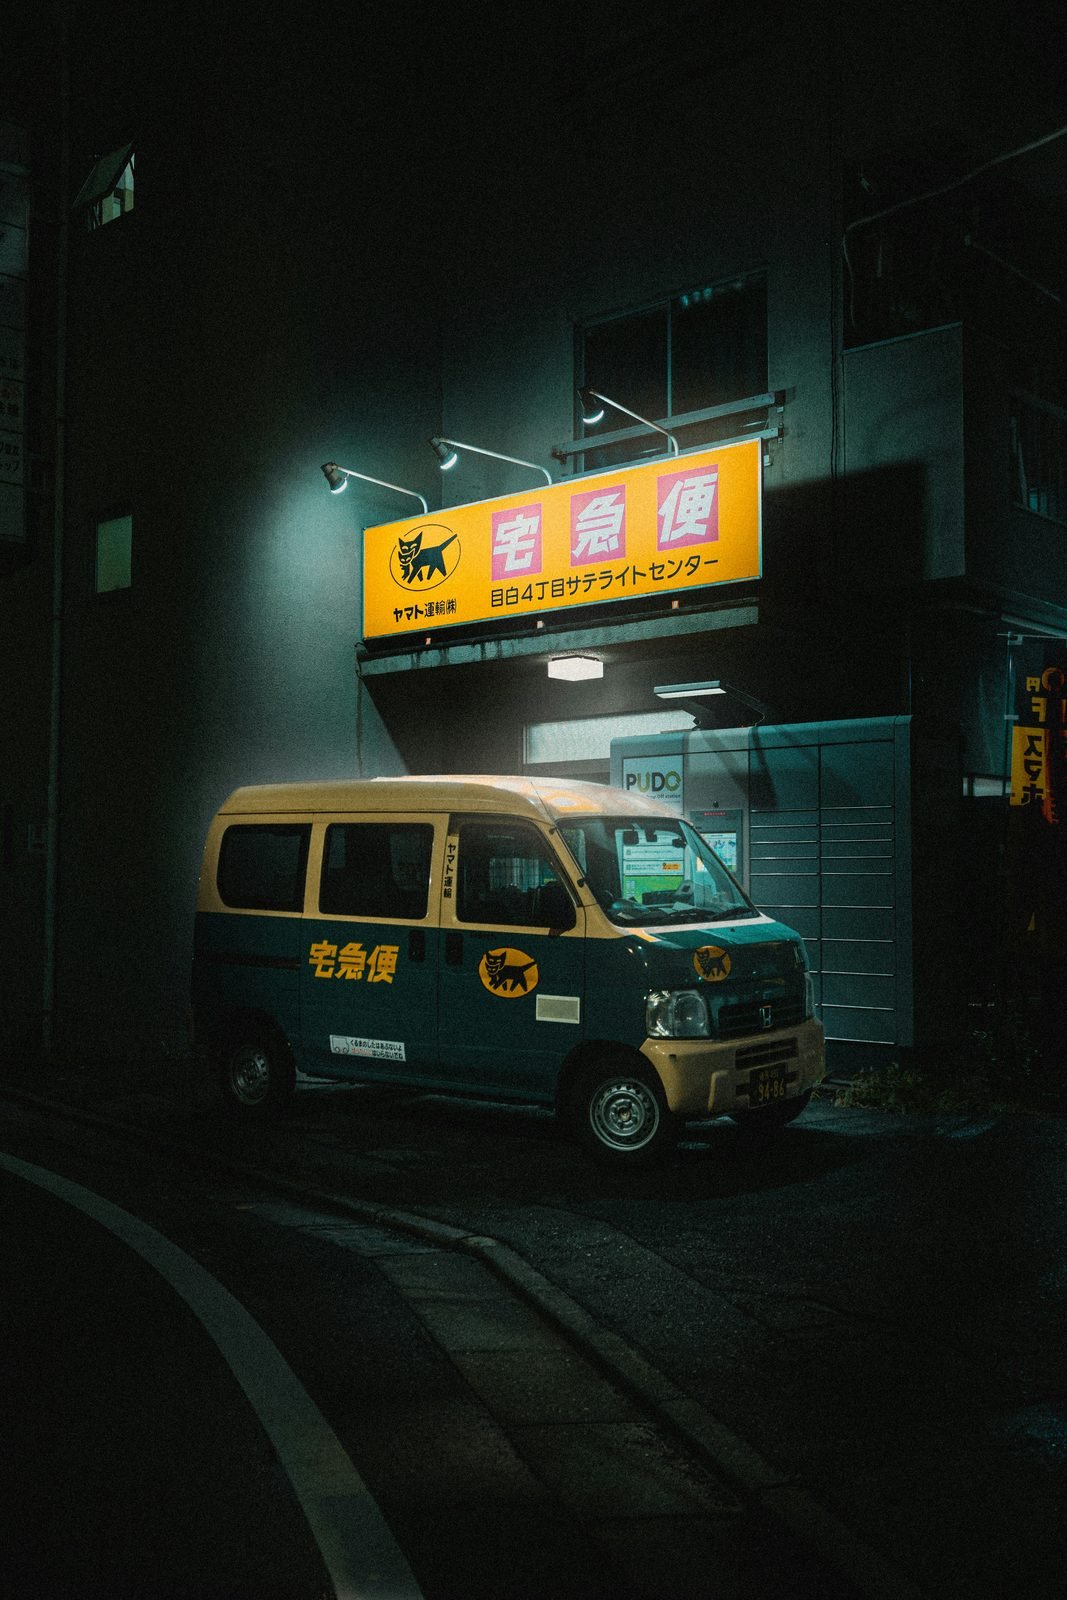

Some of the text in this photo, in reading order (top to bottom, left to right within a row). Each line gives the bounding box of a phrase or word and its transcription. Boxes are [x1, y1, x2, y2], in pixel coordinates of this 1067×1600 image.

[493, 472, 718, 573] 宅急便
[491, 555, 719, 608] 目白4丁目サテライトセンター
[626, 770, 682, 793] PUDO
[443, 843, 457, 899] ヤマト運輸
[308, 939, 400, 984] 宅急便
